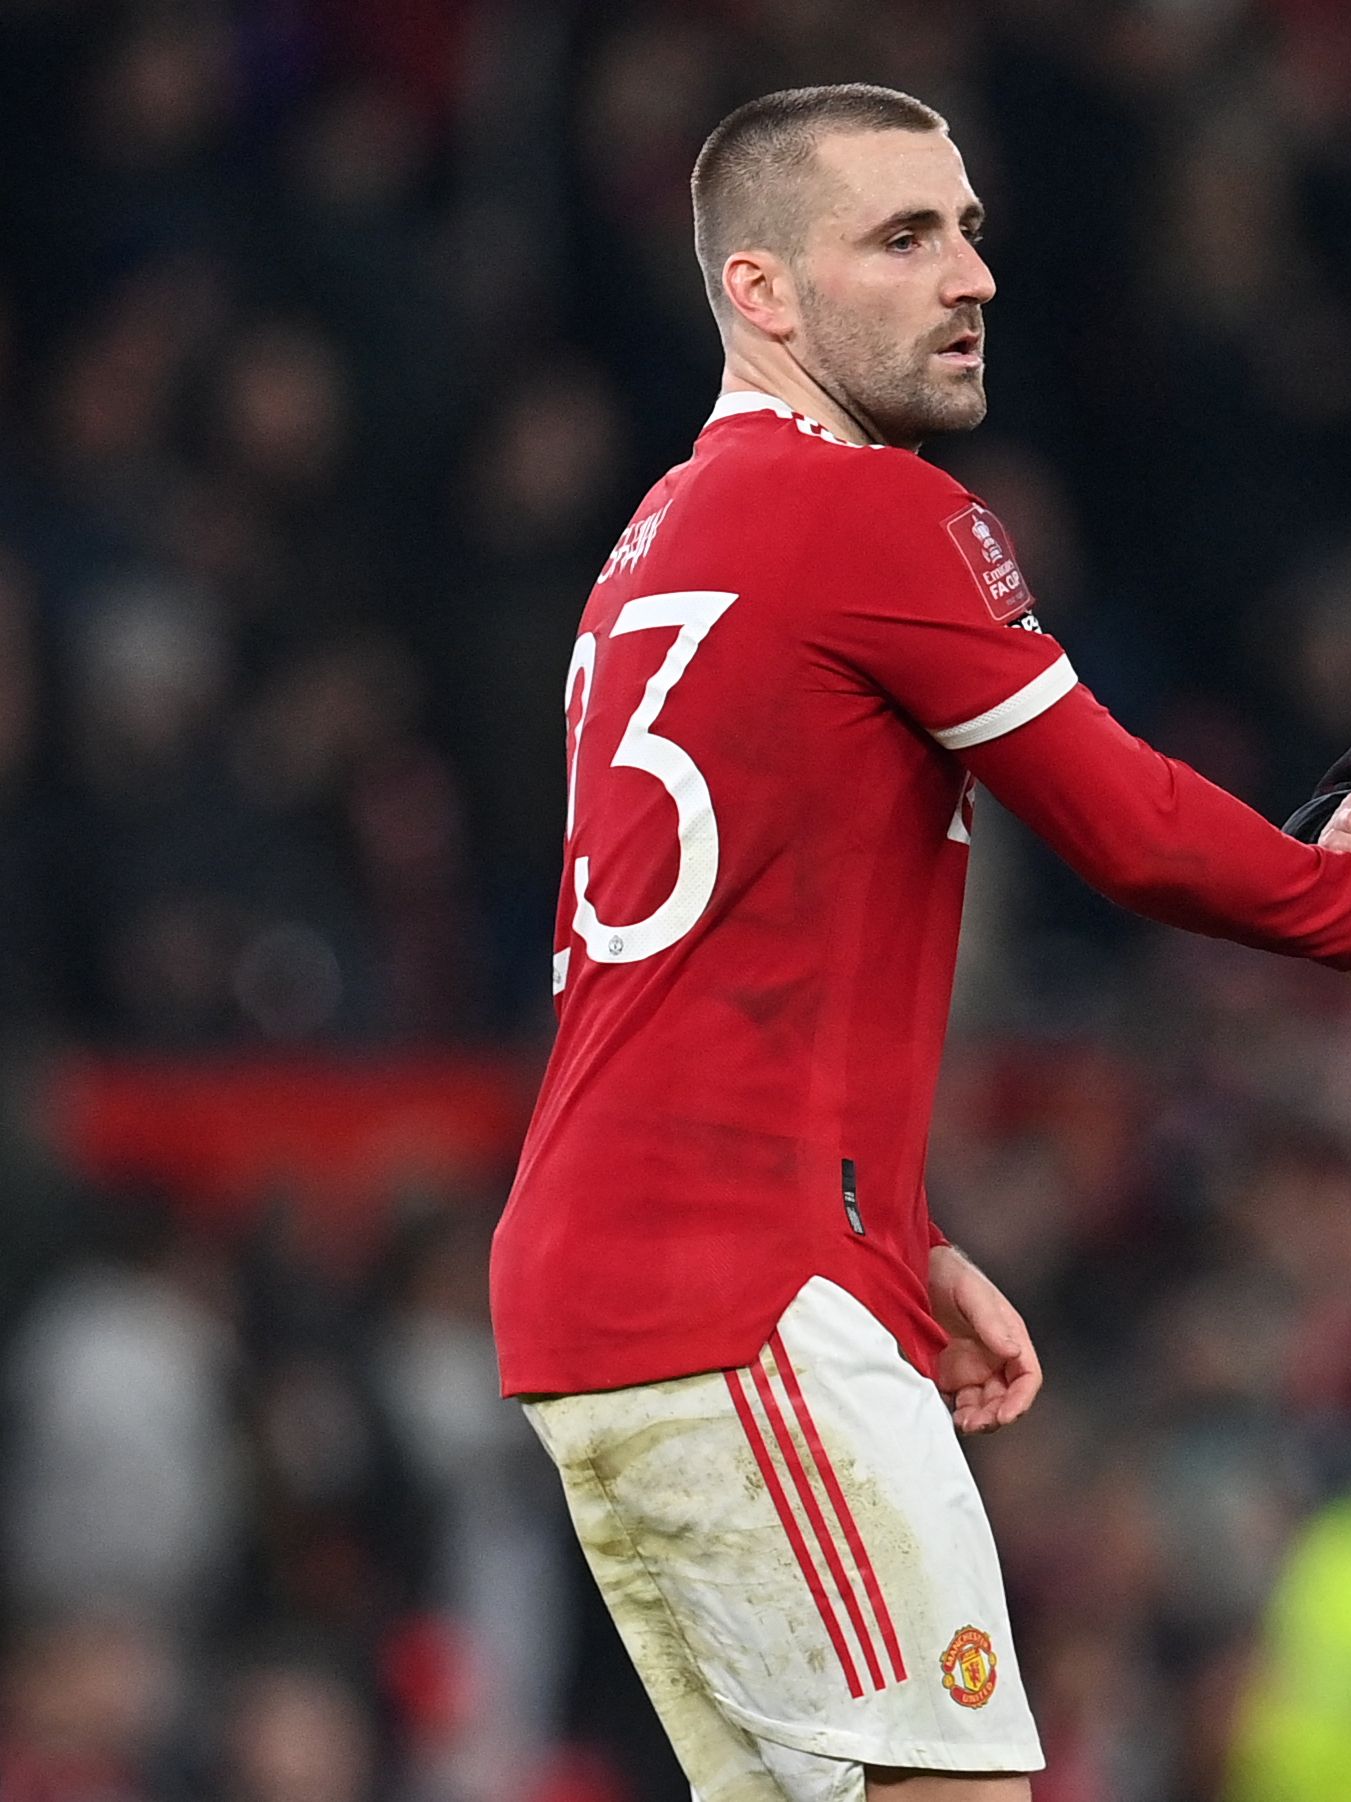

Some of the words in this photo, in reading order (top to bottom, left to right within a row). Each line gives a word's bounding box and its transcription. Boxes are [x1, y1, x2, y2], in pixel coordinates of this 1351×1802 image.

[990, 581, 1009, 600] FA
[945, 1631, 989, 1667] MANCHESTER
[961, 1680, 993, 1703] UNITED
